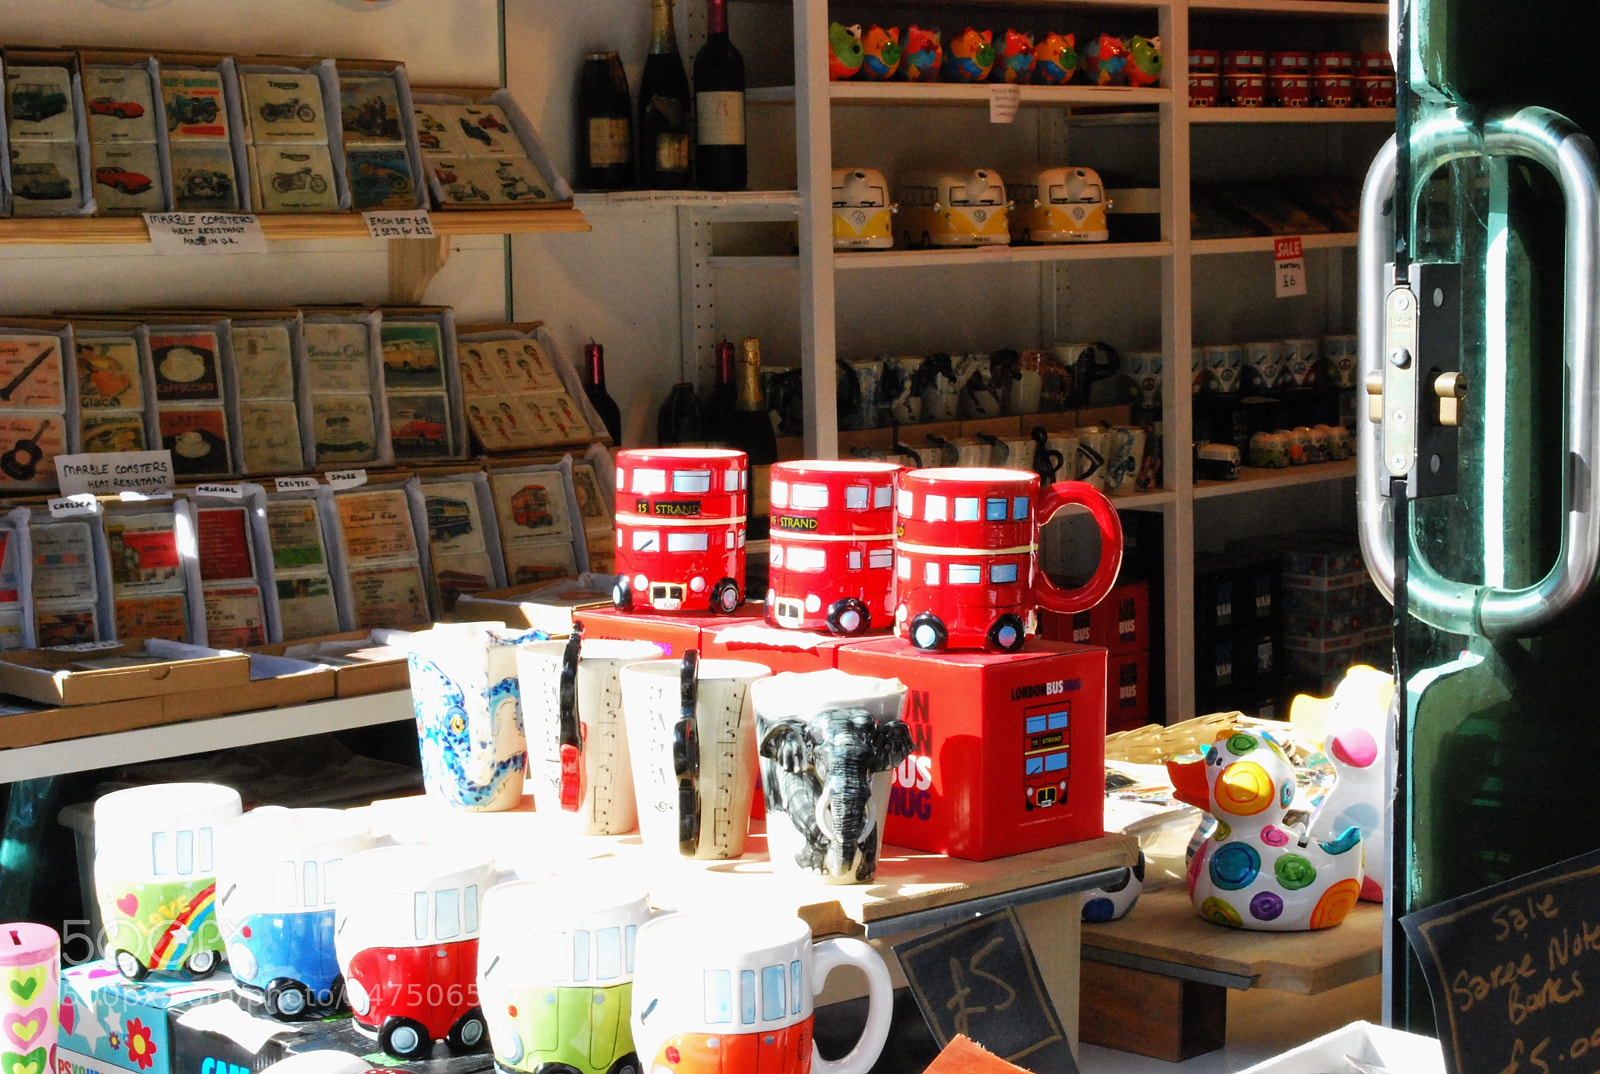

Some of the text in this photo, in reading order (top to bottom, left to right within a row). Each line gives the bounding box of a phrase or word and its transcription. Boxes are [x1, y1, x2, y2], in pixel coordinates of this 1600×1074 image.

[149, 214, 254, 226] MARBLE COASTERS
[370, 216, 392, 227] EACH
[171, 226, 193, 235] HEAT
[1277, 241, 1301, 257] SALE
[64, 461, 168, 478] MARBLE COASTERS
[88, 475, 167, 489] HEAT RESISTANT
[278, 480, 311, 488] CELTIC
[198, 485, 238, 494] ARSENAL
[637, 503, 701, 515] 15 STRAND
[780, 515, 818, 530] STRAND
[1256, 594, 1271, 608] VAN
[1216, 603, 1232, 616] VAN
[1119, 619, 1136, 634] BUS
[1073, 627, 1090, 641] BUS
[1216, 663, 1232, 677] VAN
[1120, 685, 1137, 699] BUS
[1491, 893, 1560, 942] Sale
